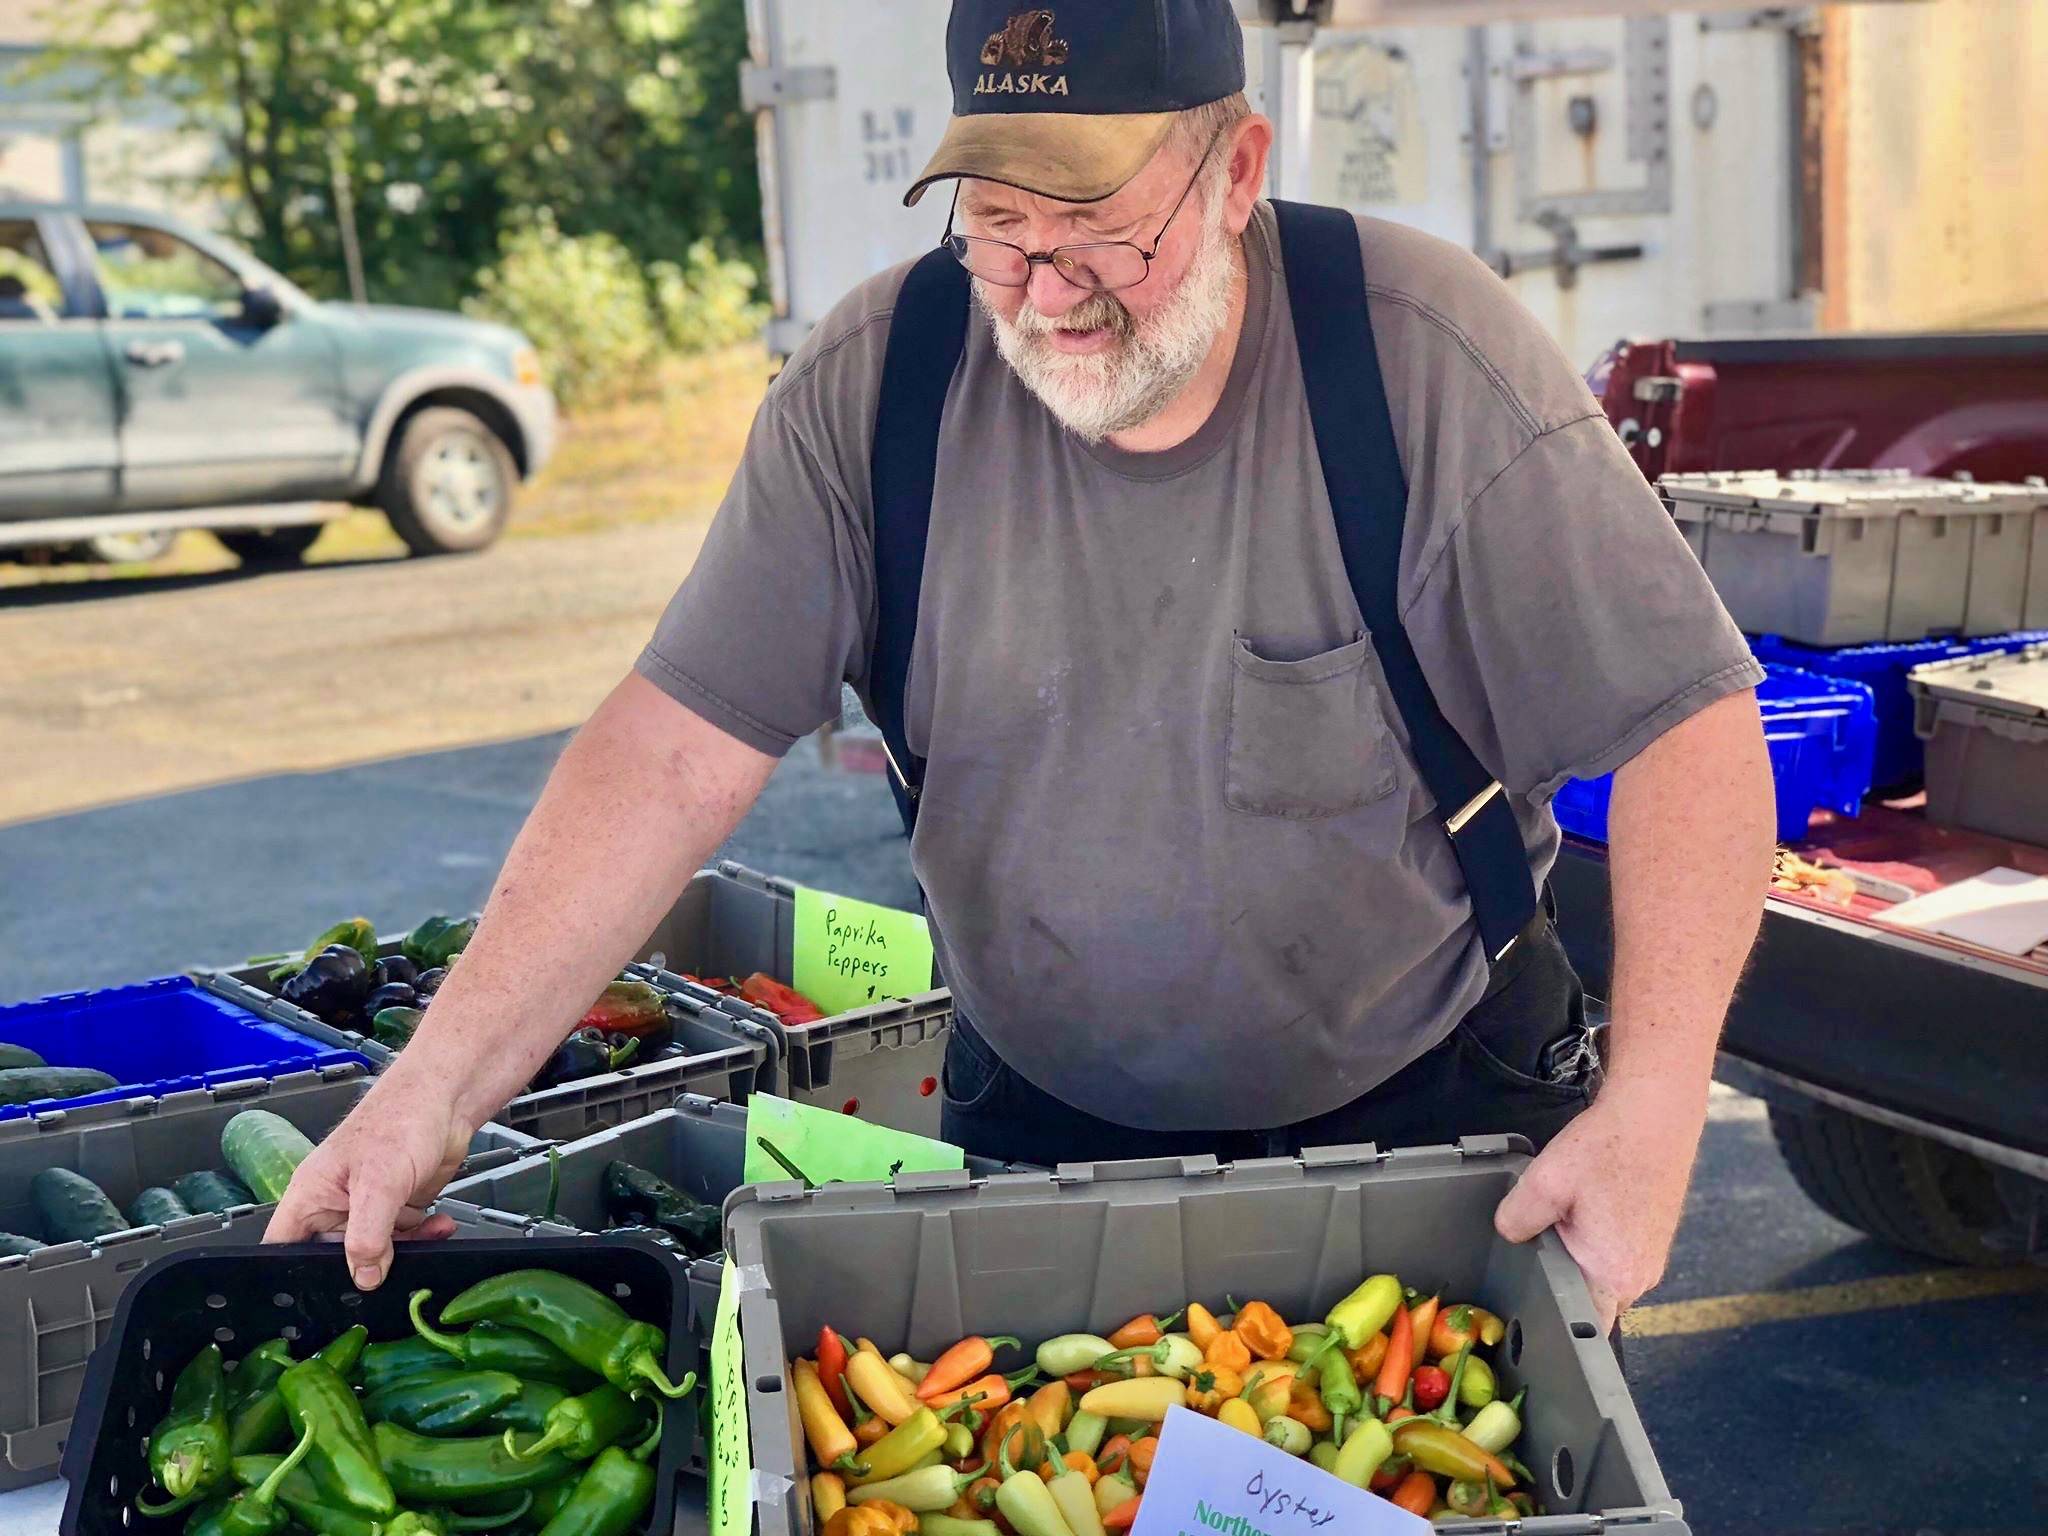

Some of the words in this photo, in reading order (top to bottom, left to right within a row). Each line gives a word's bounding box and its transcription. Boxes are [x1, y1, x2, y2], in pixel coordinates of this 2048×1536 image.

[973, 72, 1069, 96] ALASKA
[826, 909, 886, 949] Paprika
[828, 944, 888, 978] Peppers
[1193, 1499, 1272, 1536] Northe
